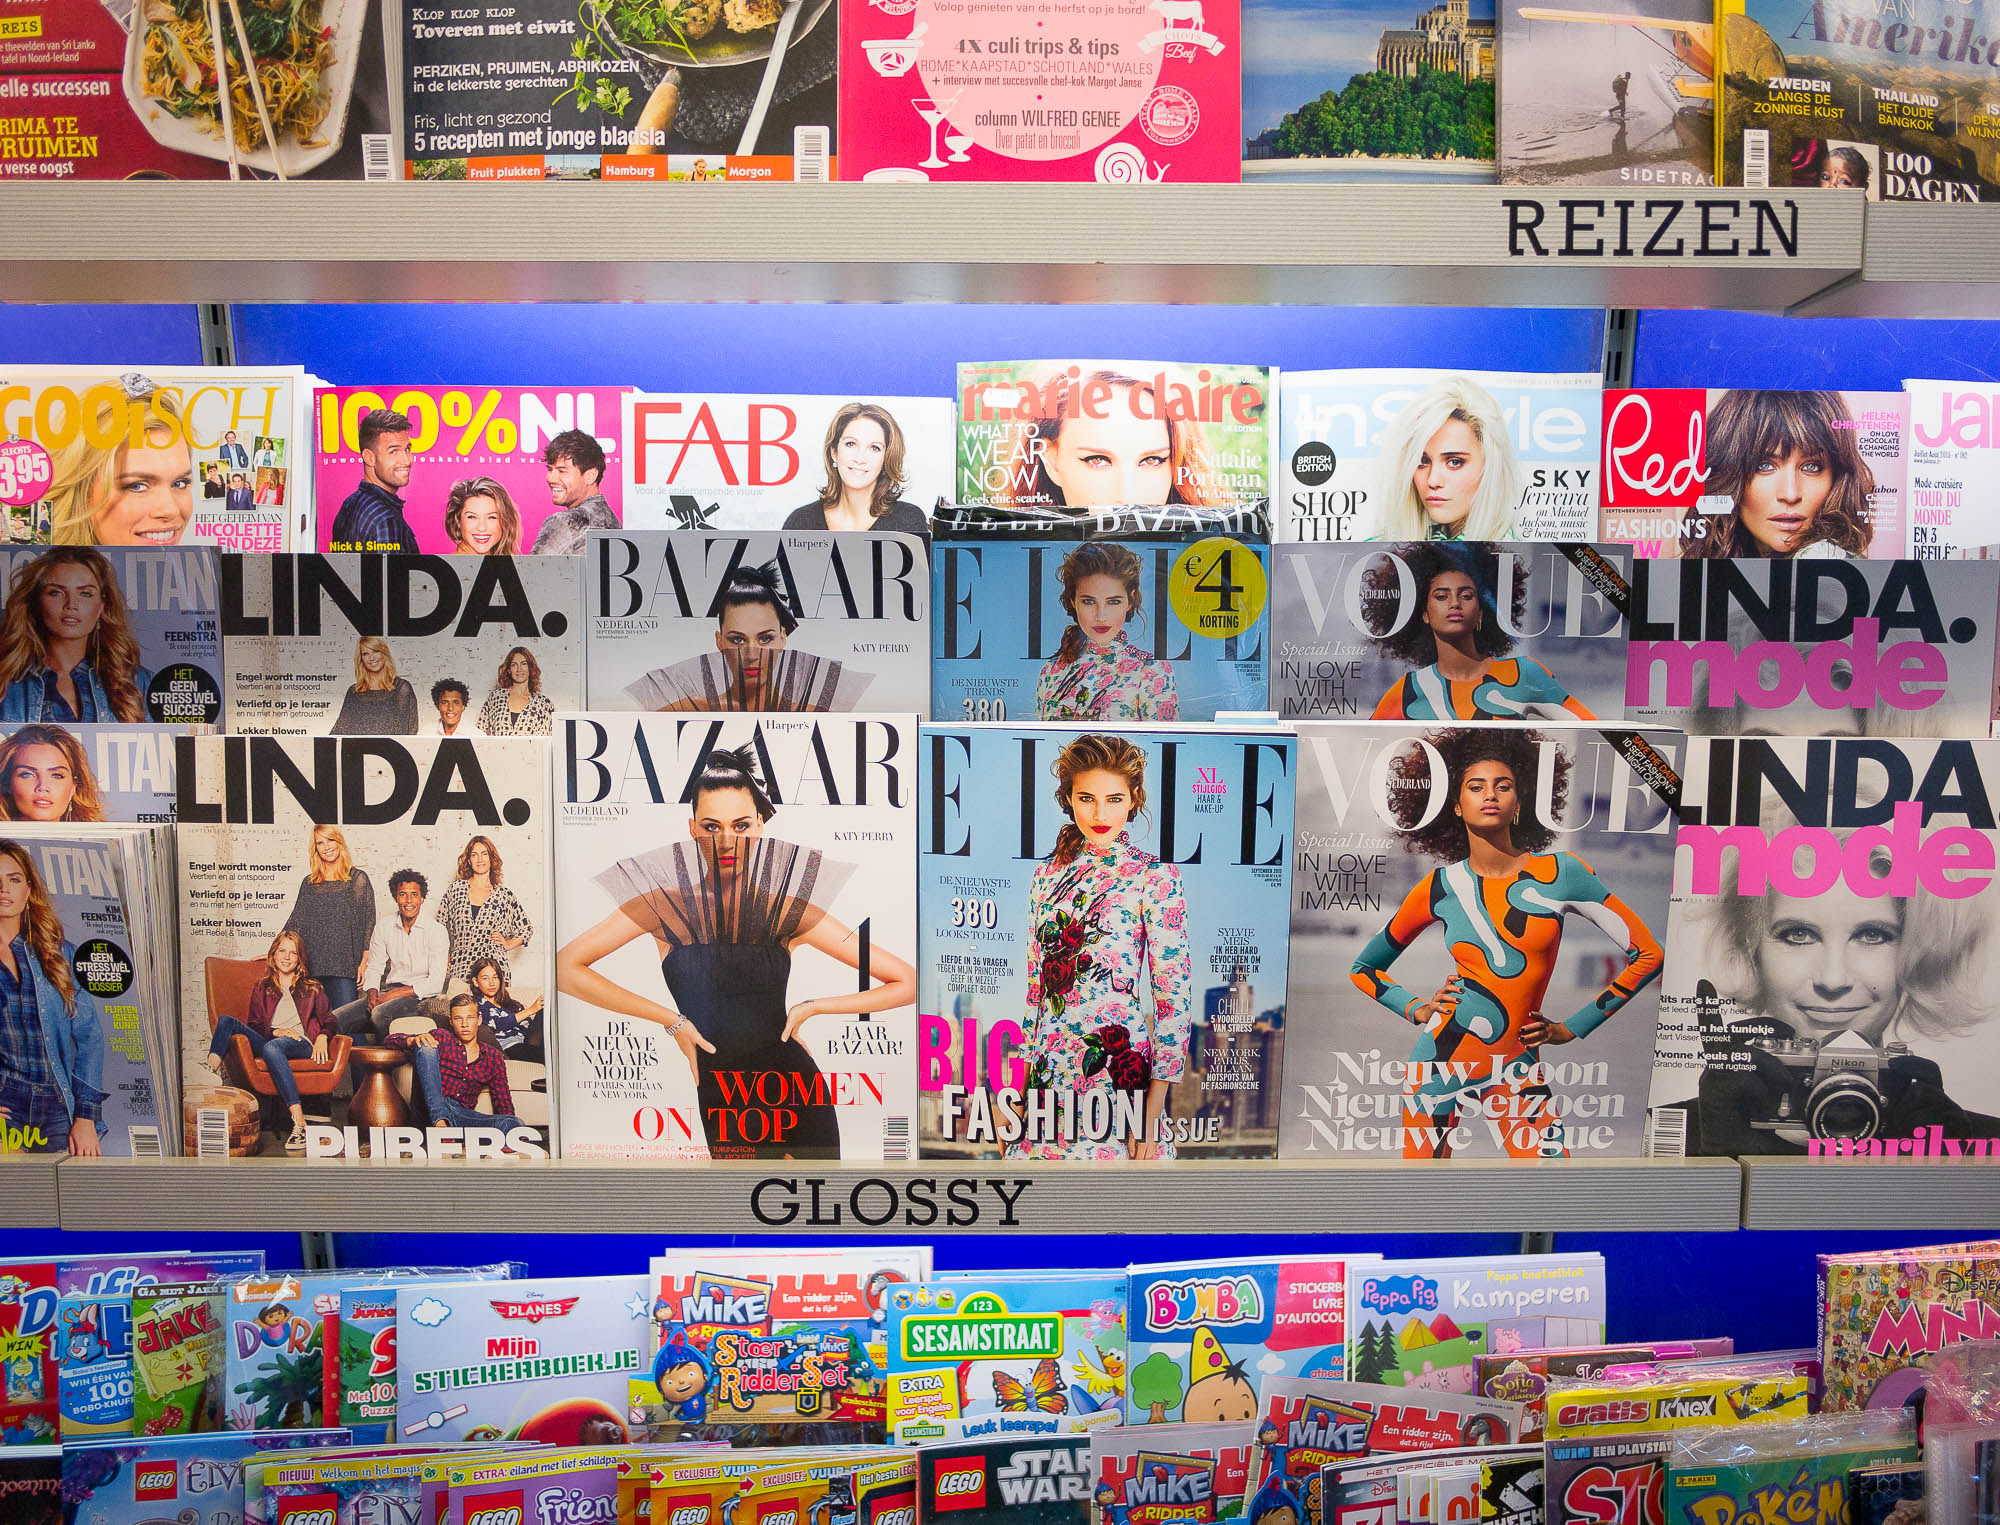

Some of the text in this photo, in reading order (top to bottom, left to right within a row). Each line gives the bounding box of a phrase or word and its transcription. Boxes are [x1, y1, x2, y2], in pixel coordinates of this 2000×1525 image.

[413, 20, 575, 39] Toveren met eiwit
[954, 37, 1119, 56] 4X culi trips & tips
[413, 59, 640, 79] PERZIKEN, PRUIMEN, ABRIKOZEN
[32, 77, 110, 98] successen
[1768, 77, 1831, 92] ZWEDEN
[1768, 91, 1831, 105] LANGS DE
[1871, 87, 1939, 107] THAILAND
[975, 110, 1121, 129] column WILFRED GENEE
[1754, 103, 1845, 119] ZONNIGE KUST
[1877, 102, 1934, 119] HET OUDE
[1878, 114, 1934, 131] BANGKOK
[414, 125, 665, 153] 5 recepten met jonge bladsla
[5, 160, 74, 177] verse oogst
[605, 165, 655, 179] Hamburg
[729, 165, 772, 179] Morgon
[1885, 151, 1932, 175] 100
[470, 166, 541, 180] Fruit plukken
[1886, 174, 1981, 203] DAGEN
[1503, 199, 1799, 258] REIZEN
[962, 365, 1263, 424] marie claire
[962, 423, 1039, 440] WHAT TO
[634, 401, 800, 486] FAB
[964, 438, 1048, 465] WEAR
[1607, 393, 1712, 503] Red
[1296, 462, 1332, 473] EDITION
[1298, 454, 1331, 464] BRITISH
[964, 465, 1039, 492] NOW
[1175, 466, 1262, 488] Portman
[1533, 469, 1590, 488] SKY
[1291, 490, 1367, 518] SHOP
[1914, 491, 1960, 508] TOUR DU
[1914, 509, 1952, 525] MONDE
[195, 523, 282, 536] NICOLETTE
[1291, 516, 1352, 542] THE
[1605, 517, 1707, 539] FASHION'S
[1914, 527, 1937, 543] EN 3
[217, 536, 282, 550] EN DEZE
[329, 541, 400, 552] Nick & Simon
[592, 536, 923, 622] BAZAAR
[221, 554, 568, 638] LINDA.
[1628, 558, 1977, 644] LINDA.
[196, 620, 216, 632] KIM
[1199, 615, 1239, 628] KORTING
[164, 632, 217, 642] FEENSTRA
[1625, 617, 1948, 710] mode
[765, 719, 810, 733] Harper's
[558, 718, 909, 808] BAZAAR
[176, 736, 531, 826] LINDA.
[1197, 767, 1224, 785] XL
[1192, 783, 1227, 794] STIJLGIDS
[922, 733, 1288, 867] ELLE
[562, 805, 628, 816] NEDERLAND
[834, 830, 894, 841] KATY PERRY
[1671, 801, 1995, 899] mode
[189, 862, 291, 872] Engel wordt monster
[1297, 854, 1387, 875] IN LOVE
[1313, 873, 1369, 893] WITH
[189, 889, 286, 902] Verliefd op je leraar
[1300, 892, 1381, 912] IMAAN
[190, 918, 262, 928] Lekker blowen
[951, 898, 997, 929] 380
[936, 929, 1015, 942] LOOKS TO LOVE
[76, 960, 130, 972] STRESS WÉL
[90, 953, 114, 962] GEEN
[87, 972, 122, 982] SUCCES
[607, 1021, 631, 1036] DE
[842, 1025, 888, 1041] JAAR
[584, 1036, 656, 1052] NIEUWE
[827, 1039, 903, 1056] BAZAAR!
[582, 1051, 659, 1067] NAJAARS
[919, 1014, 1025, 1095] BIG
[1653, 1050, 1752, 1062] Yvonne Keuls (83)
[1831, 1058, 1866, 1068] Nikon
[593, 1066, 647, 1081] MODE
[1328, 1048, 1481, 1087] Nieuw
[709, 1070, 887, 1106] WOMEN
[1300, 1081, 1625, 1119] Nieuw Seizoen
[942, 1083, 1146, 1143] FASHION
[633, 1106, 799, 1143] ON TOP
[1153, 1117, 1220, 1143] ISSUE
[1304, 1116, 1615, 1157] Nieuwe Vogue
[750, 1178, 1033, 1226] GLOSSY
[1151, 1282, 1258, 1325] BUMBA
[1365, 1279, 1435, 1309] Peppa Pig
[1453, 1280, 1590, 1316] Kamperen
[508, 1303, 562, 1317] PLANES
[973, 1301, 993, 1312] 123
[138, 1301, 222, 1355] JAKE
[6, 1339, 33, 1351] WIN
[234, 1316, 323, 1361] DORA
[911, 1323, 1054, 1353] SESAMSTRAAT
[487, 1337, 537, 1359] Mijn
[415, 1350, 638, 1392] STICKERBOEKJE
[899, 1376, 944, 1393] EXTRA
[1558, 1401, 1651, 1427] Gratis
[962, 1418, 1059, 1438] Leuk leerspel
[138, 1469, 176, 1490] LEGO
[936, 1470, 984, 1495] LEGO
